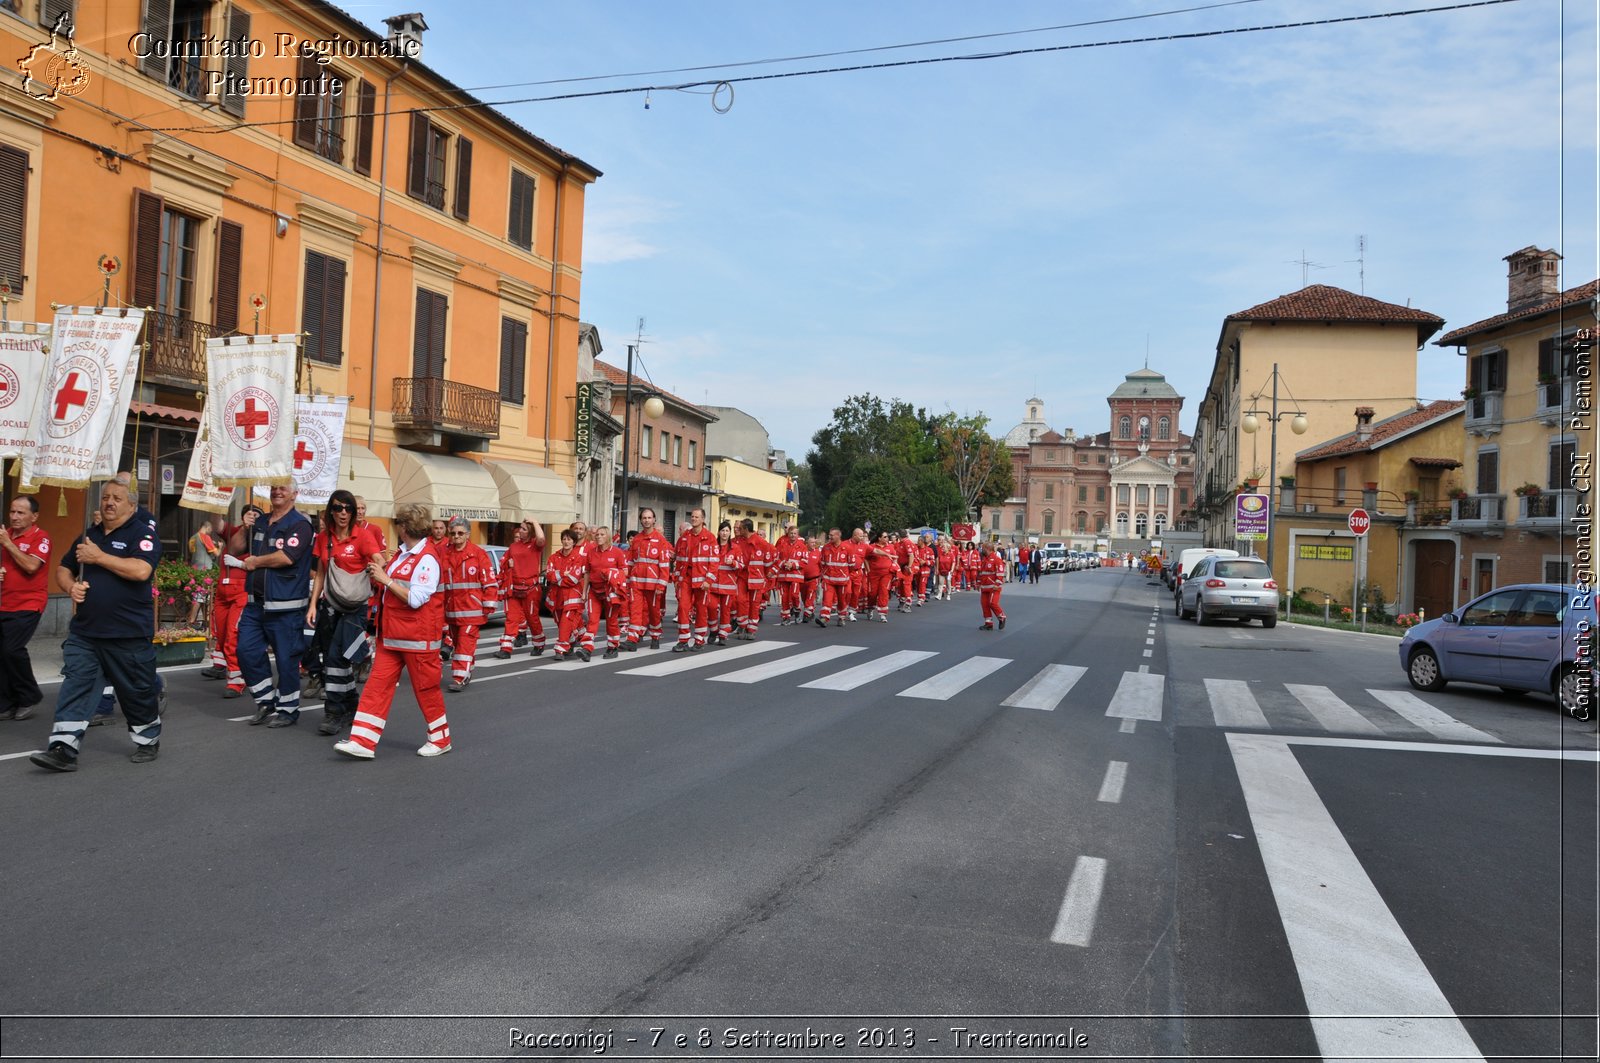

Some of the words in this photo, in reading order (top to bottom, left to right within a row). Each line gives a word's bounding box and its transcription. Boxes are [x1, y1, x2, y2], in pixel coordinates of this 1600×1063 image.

[63, 340, 97, 357] ROSSA
[263, 394, 272, 403] 22
[578, 384, 590, 421] ANTICO
[0, 438, 9, 446] EL
[10, 439, 36, 448] BOSCO
[577, 423, 589, 454] FORNO
[297, 487, 332, 497] MOROZZO
[1350, 516, 1369, 527] STOP
